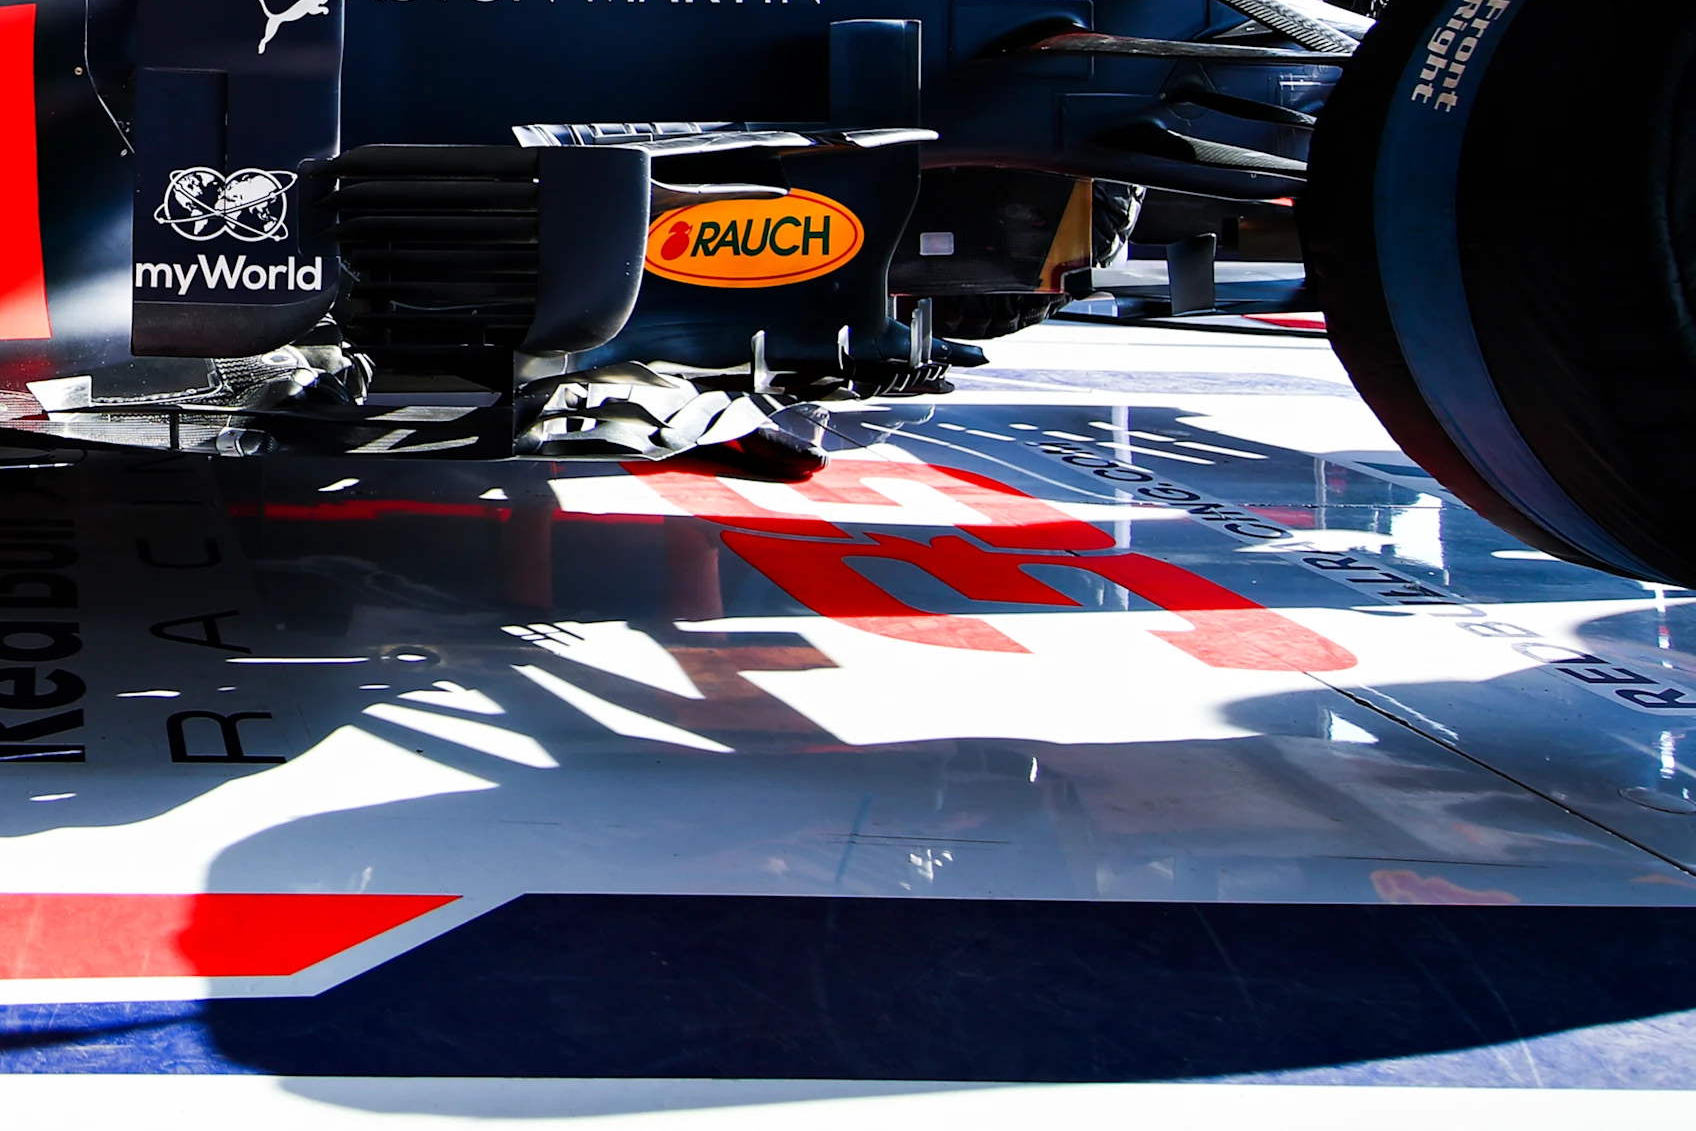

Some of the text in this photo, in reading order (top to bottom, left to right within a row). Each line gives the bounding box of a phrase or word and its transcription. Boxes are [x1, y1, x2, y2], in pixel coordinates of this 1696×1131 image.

[690, 215, 831, 258] RAUCH
[135, 254, 322, 296] myWorld
[126, 453, 287, 764] RACIN
